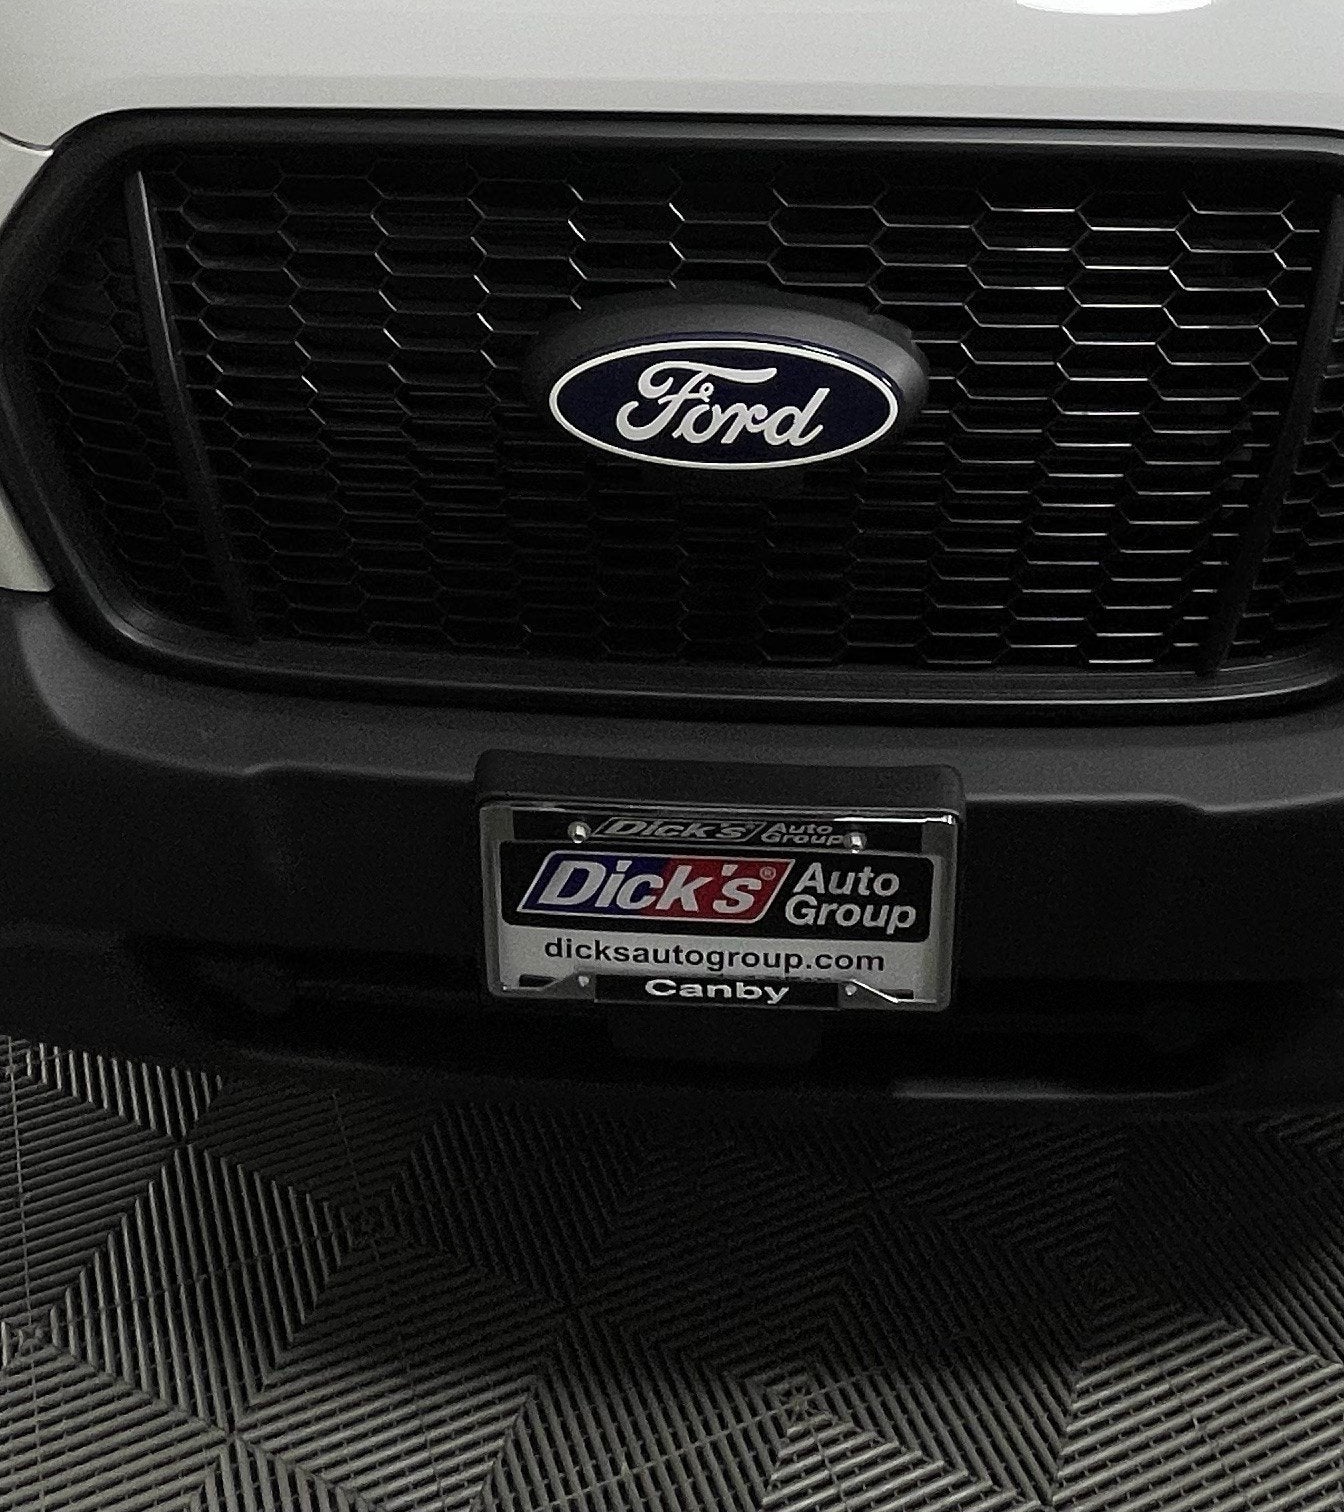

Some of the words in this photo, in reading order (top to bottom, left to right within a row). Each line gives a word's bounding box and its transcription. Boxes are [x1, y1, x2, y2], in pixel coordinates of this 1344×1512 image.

[616, 360, 831, 447] Ford
[761, 831, 845, 846] Group
[768, 823, 834, 834] Auto
[794, 861, 899, 897] Auto
[784, 895, 918, 936] Group
[544, 937, 886, 973] dicksautogroup.com
[644, 978, 790, 1005] Canby
